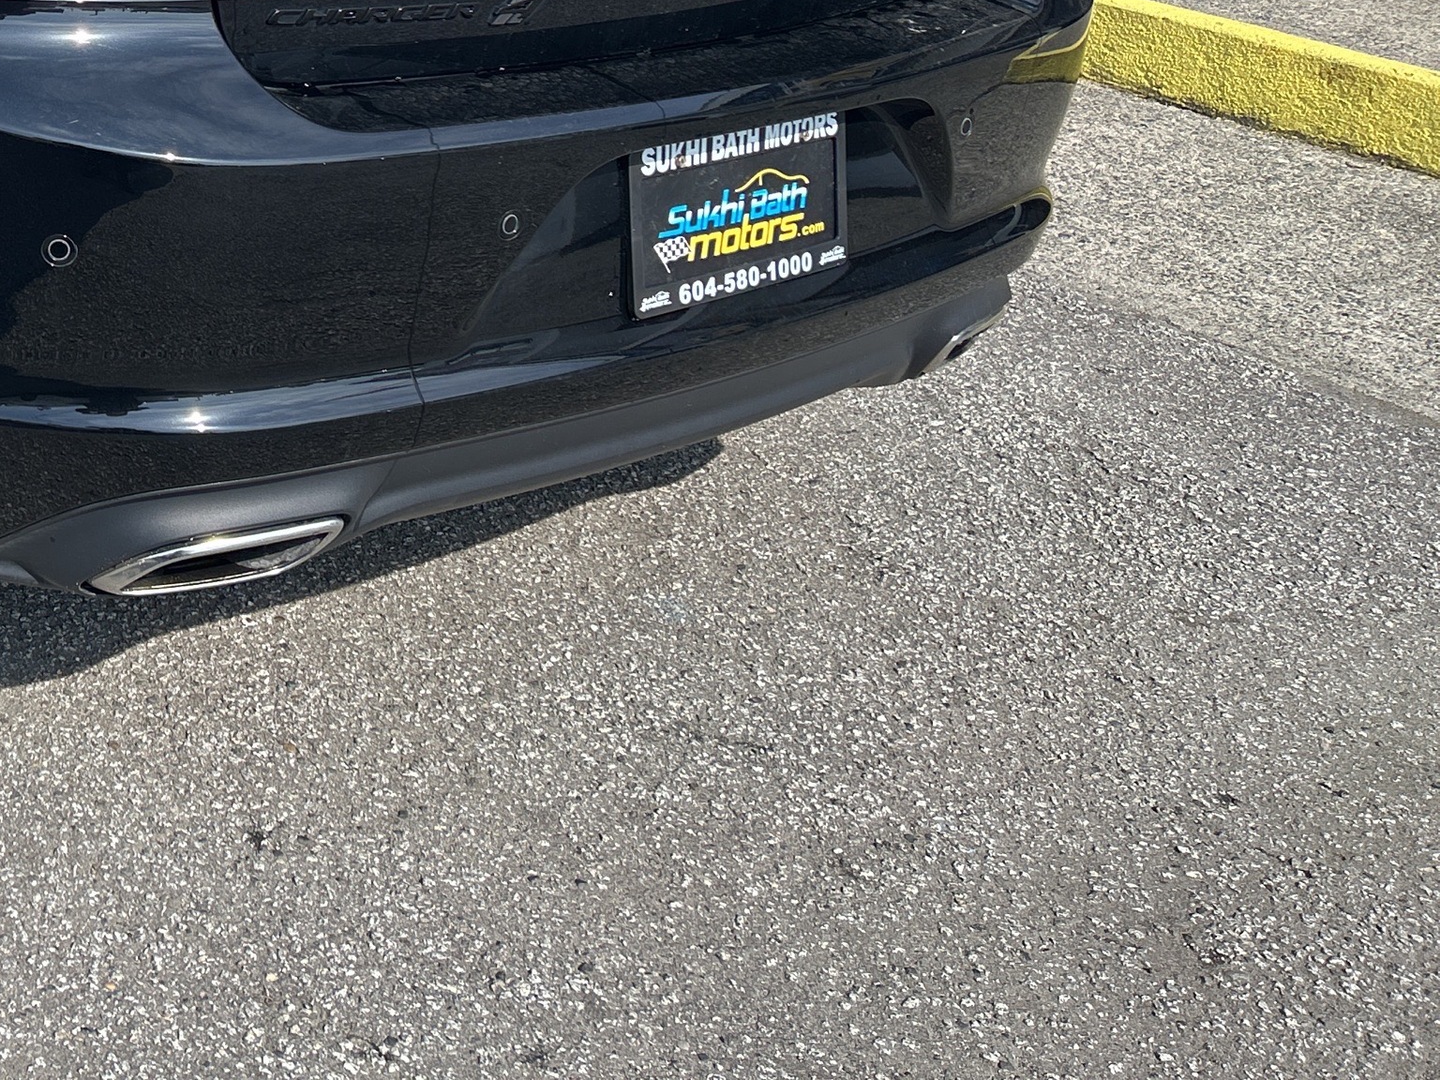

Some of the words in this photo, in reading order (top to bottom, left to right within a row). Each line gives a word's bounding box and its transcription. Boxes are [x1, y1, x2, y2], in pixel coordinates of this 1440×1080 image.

[265, 2, 480, 26] CHARGER
[640, 138, 707, 176] SUKHI
[711, 128, 760, 161] BATH
[764, 112, 838, 151] MOTORS
[658, 188, 745, 238] Sukhi
[750, 182, 809, 220] Bath
[678, 252, 812, 305] 604-580-1000
